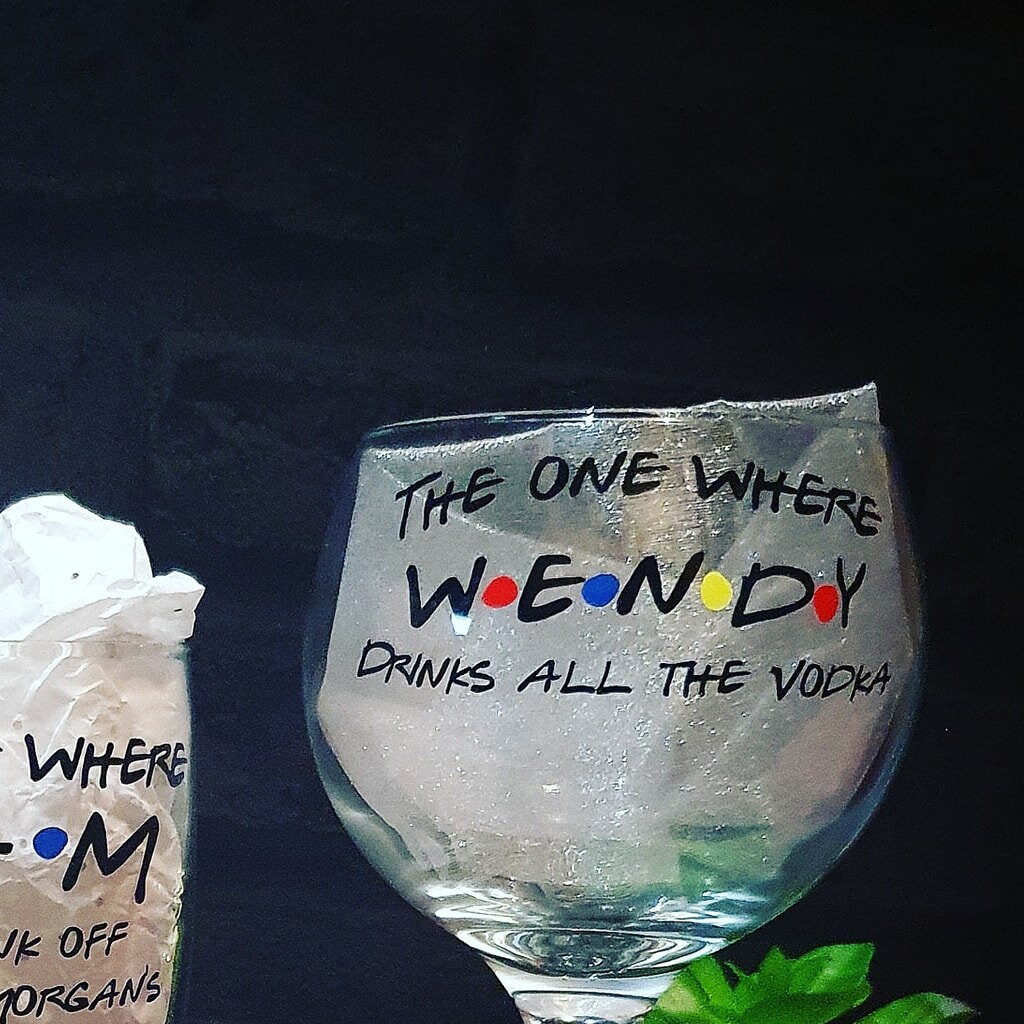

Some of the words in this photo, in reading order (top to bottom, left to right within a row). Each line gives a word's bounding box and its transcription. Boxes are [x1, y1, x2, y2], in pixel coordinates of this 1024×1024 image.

[395, 467, 505, 540] THE
[530, 451, 670, 500] ONE
[692, 455, 883, 537] WHERE
[356, 638, 496, 696] DRINKS
[517, 660, 633, 696] ALL
[660, 660, 751, 697] THE
[770, 659, 891, 703] VODKA
[24, 734, 188, 789] WHERE
[60, 920, 129, 959] OFF
